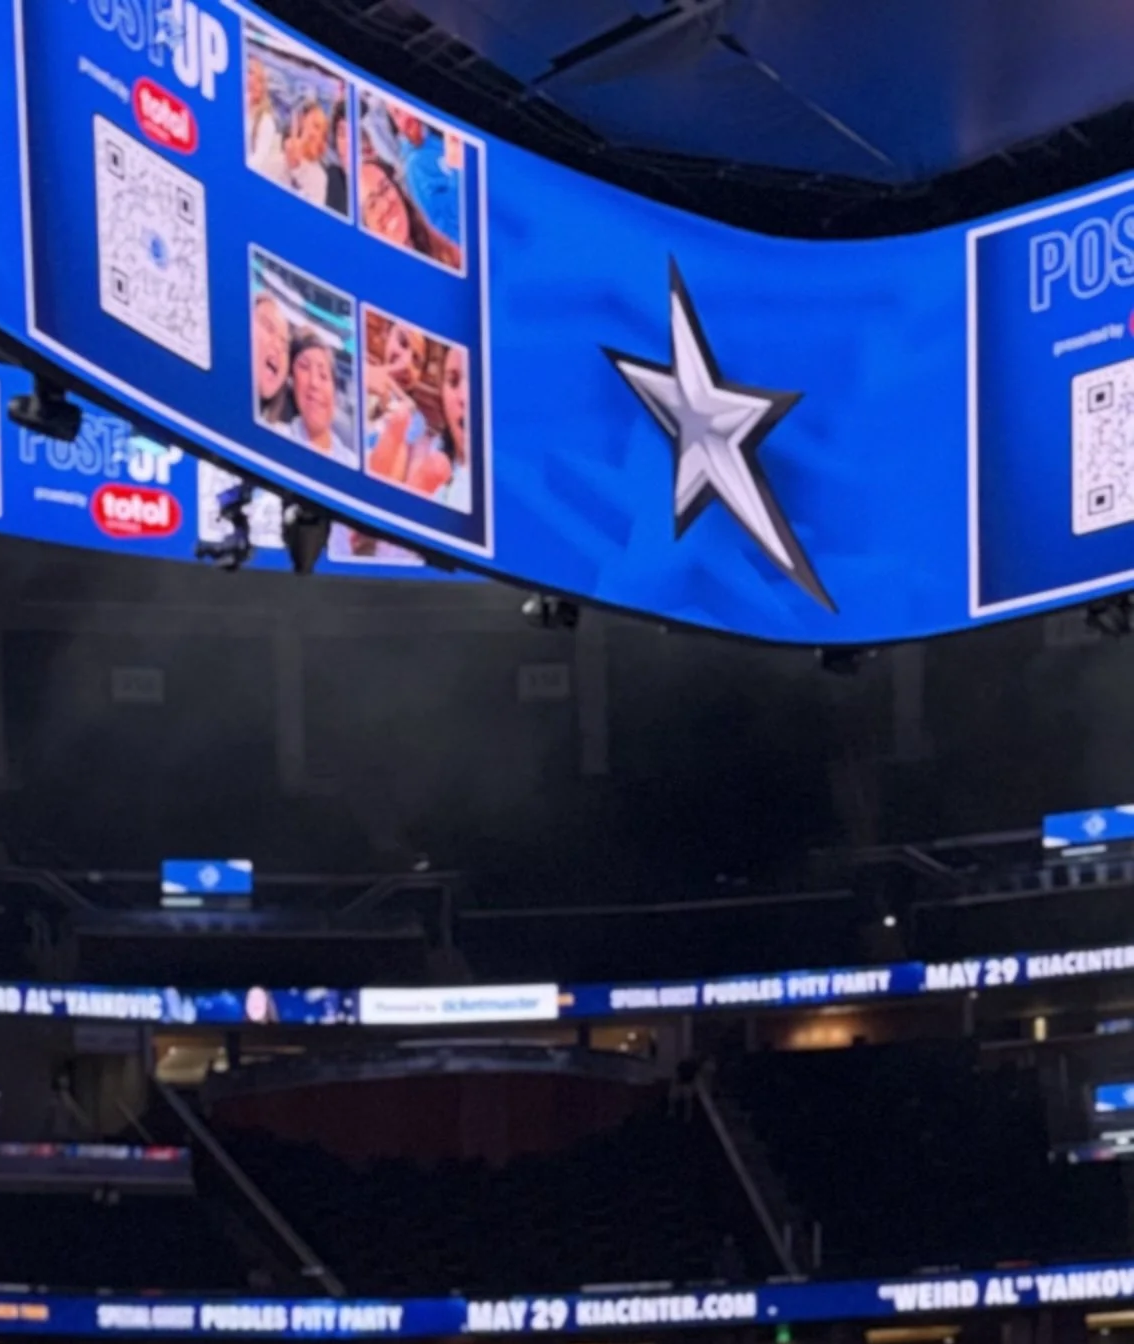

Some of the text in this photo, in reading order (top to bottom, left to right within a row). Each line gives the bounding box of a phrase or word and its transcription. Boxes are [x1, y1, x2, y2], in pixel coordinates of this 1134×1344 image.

[703, 978, 783, 1005] PUDDLES
[786, 974, 829, 999] PITY
[831, 969, 891, 994] PARTY
[926, 961, 981, 991] MAY
[984, 957, 1019, 986] 29
[200, 1304, 287, 1330] PUDDLES
[292, 1305, 338, 1330] PITY
[339, 1305, 403, 1331] PARTY
[468, 1300, 527, 1332] MAY
[530, 1298, 568, 1330] 29
[576, 1292, 757, 1326] KIACENTER.COM
[878, 1279, 978, 1312] "WEIRD
[984, 1275, 1033, 1305] AL"
